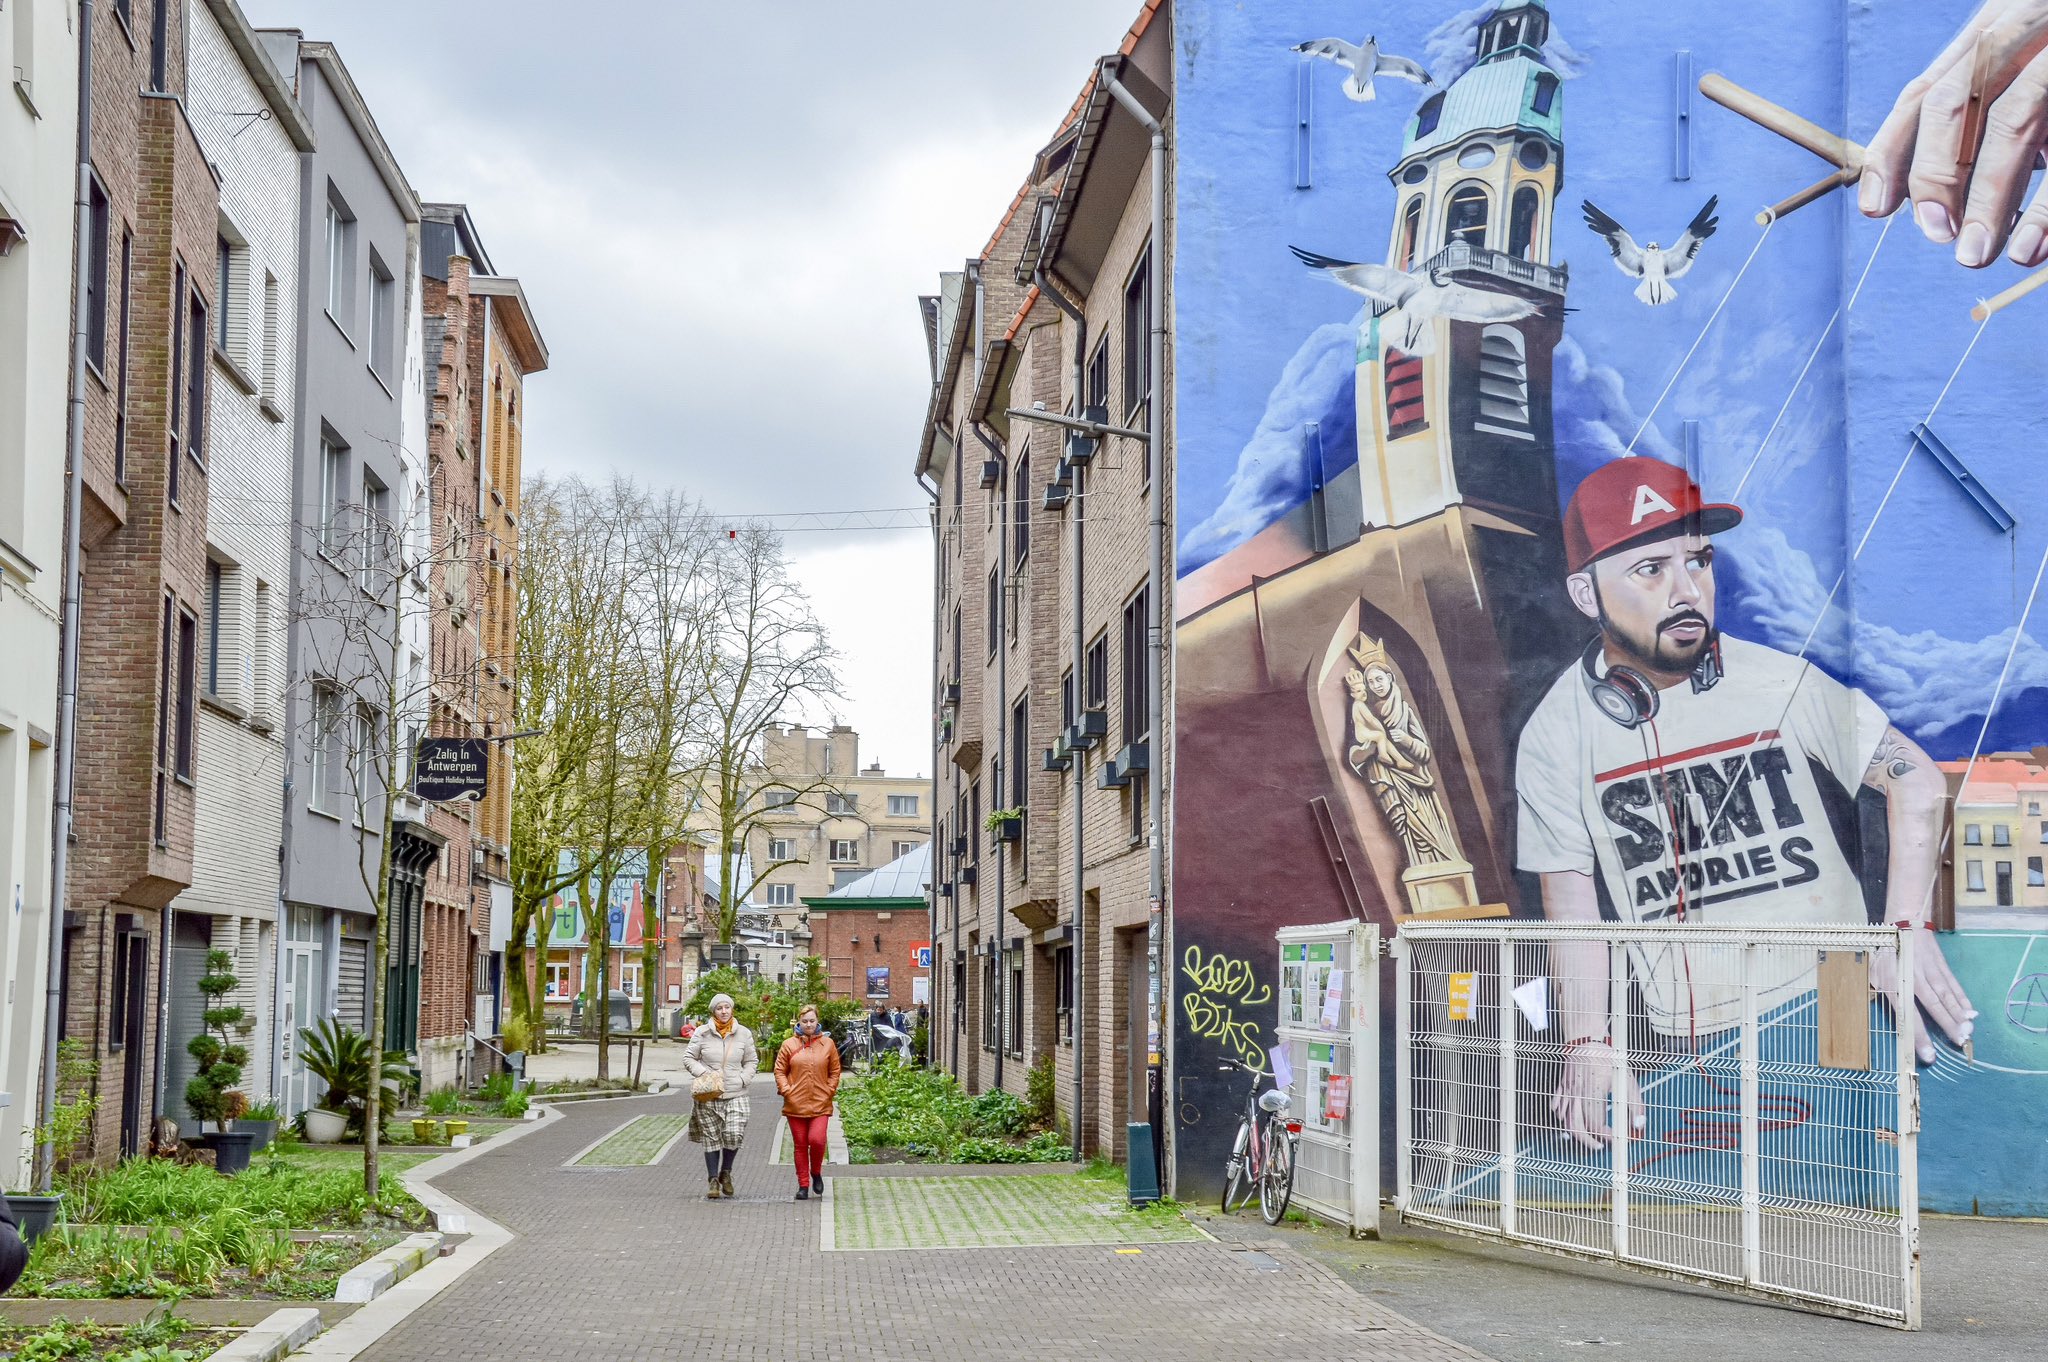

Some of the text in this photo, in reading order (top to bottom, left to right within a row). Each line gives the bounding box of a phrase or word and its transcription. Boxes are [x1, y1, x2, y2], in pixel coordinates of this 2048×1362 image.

[1631, 484, 1676, 526] A
[427, 760, 477, 773] Antwerpen
[435, 747, 470, 762] Zalig In
[418, 775, 485, 785] Boutique Holiday Homes
[1601, 746, 1805, 871] SINT
[1635, 836, 1820, 907] ANDRIES
